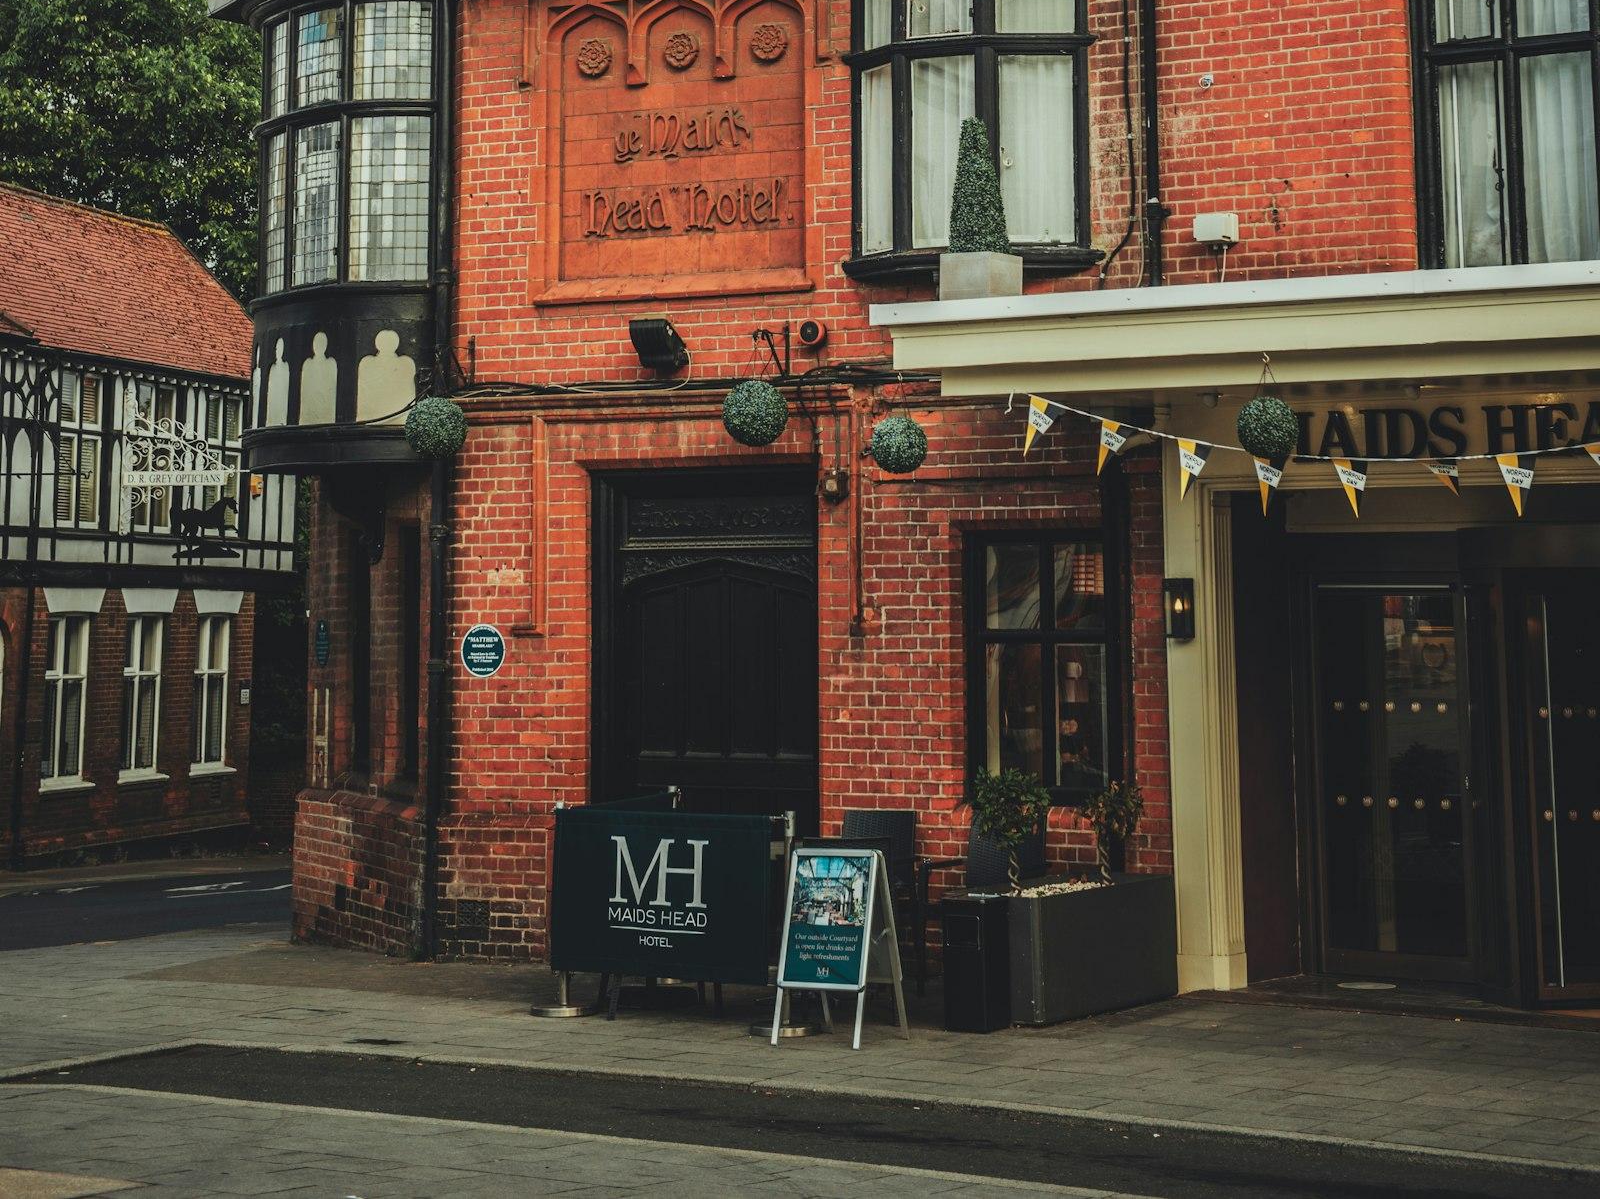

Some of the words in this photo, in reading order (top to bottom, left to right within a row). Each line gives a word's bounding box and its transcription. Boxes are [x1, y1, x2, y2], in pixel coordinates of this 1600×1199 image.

[149, 474, 172, 483] GREY
[175, 474, 221, 483] OPTICIANS
[1506, 468, 1532, 479] NORFOLK
[609, 835, 709, 908] MH
[608, 906, 656, 924] MAIDS
[660, 910, 708, 927] HEAD
[639, 935, 673, 948] HOTEL
[829, 934, 858, 943] Courtyard
